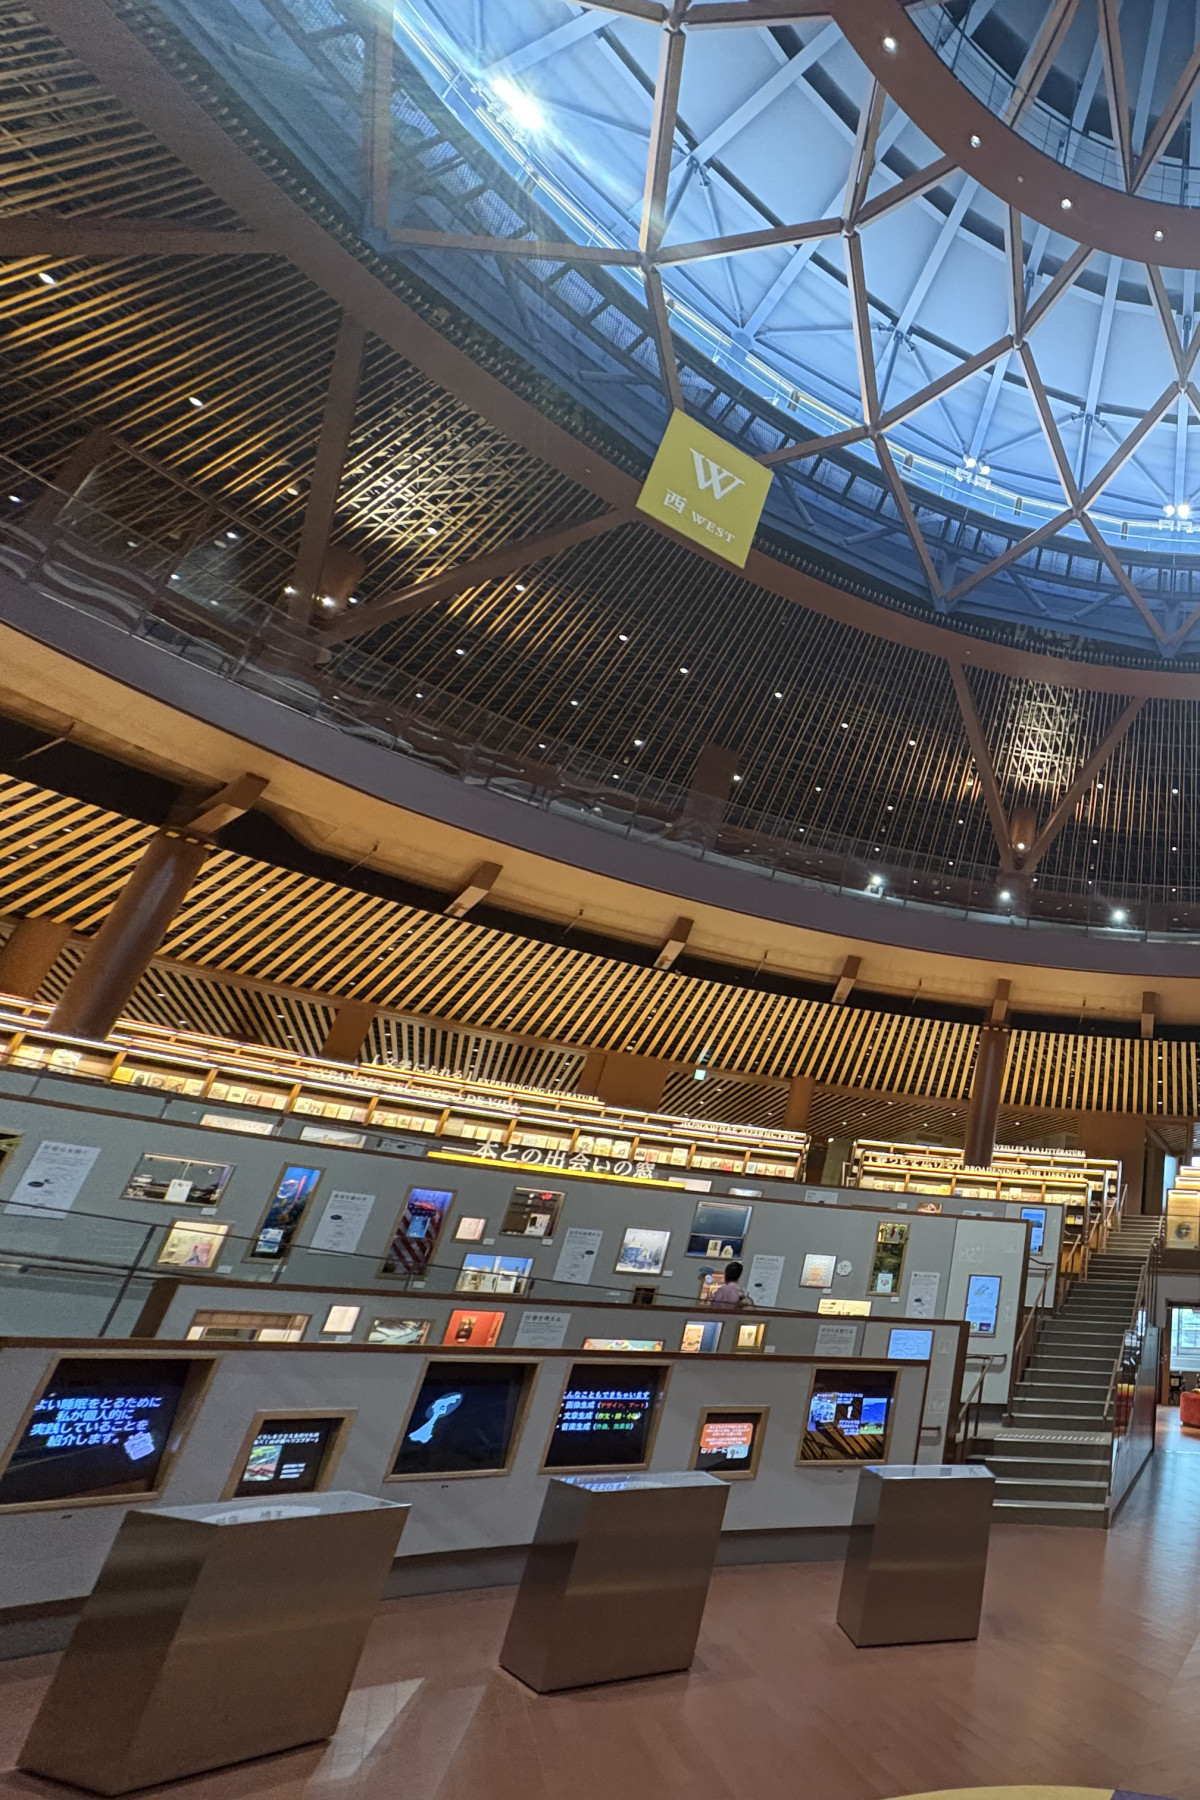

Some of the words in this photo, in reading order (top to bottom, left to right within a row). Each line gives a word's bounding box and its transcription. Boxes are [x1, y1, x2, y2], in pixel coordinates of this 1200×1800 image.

[689, 447, 745, 500] W
[663, 488, 687, 514] 西
[691, 511, 736, 543] WEST
[477, 1077, 547, 1096] EXPERIENCING
[548, 1088, 600, 1103] LITERATURE
[473, 1142, 656, 1179] 本との出会いの窓
[34, 1396, 162, 1411] よい睡眠をとるために
[55, 1409, 135, 1423] 私が個人的に
[30, 1420, 149, 1436] 実践していることを
[46, 1432, 120, 1448] 紹介します。
